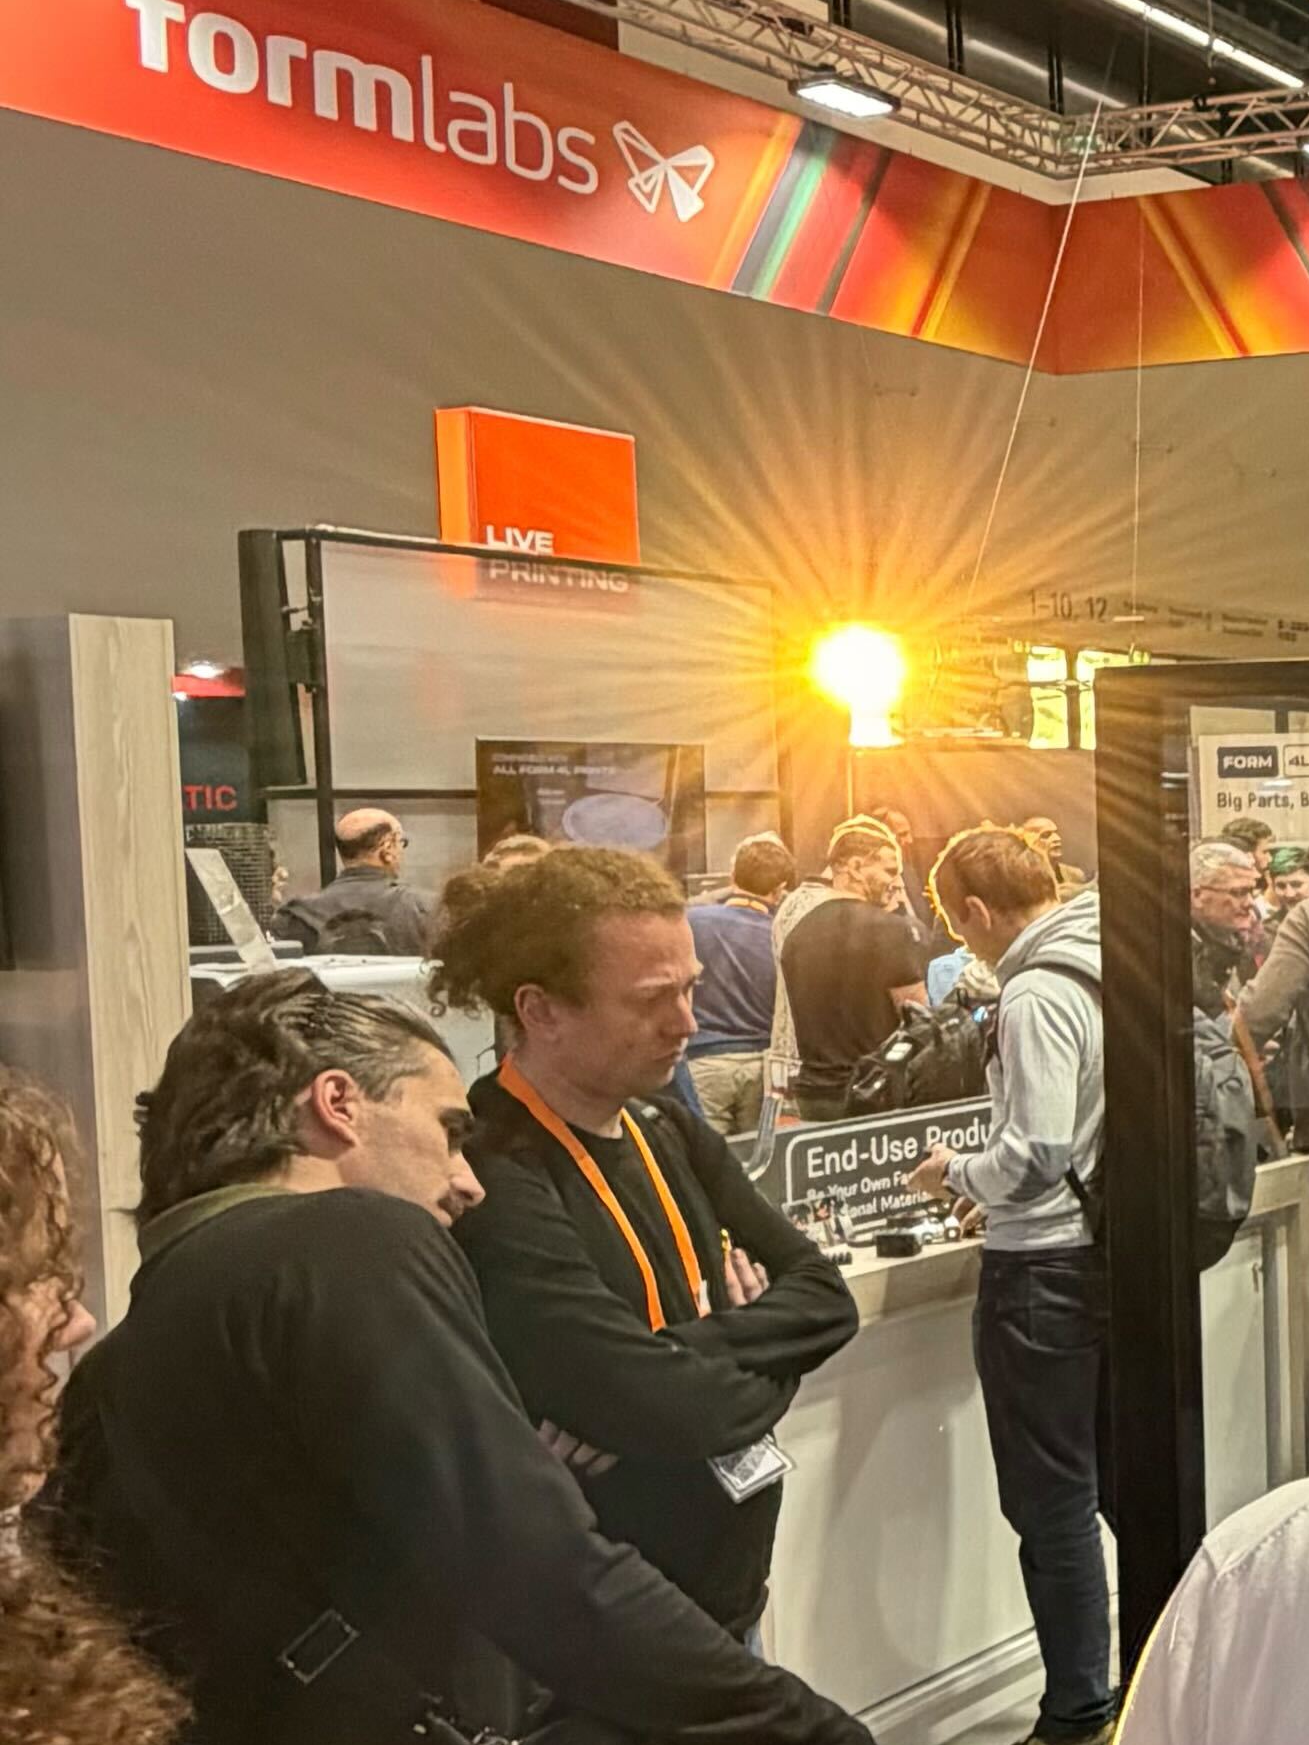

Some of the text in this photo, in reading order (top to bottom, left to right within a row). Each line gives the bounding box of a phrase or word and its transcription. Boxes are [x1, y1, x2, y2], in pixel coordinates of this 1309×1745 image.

[486, 524, 554, 555] LIVE
[488, 559, 630, 593] PRINTING
[1222, 754, 1273, 770] FORM
[1216, 791, 1243, 812] Big
[1248, 790, 1295, 810] Parts,
[807, 1133, 919, 1179] End-Use
[860, 1176, 892, 1194] Own
